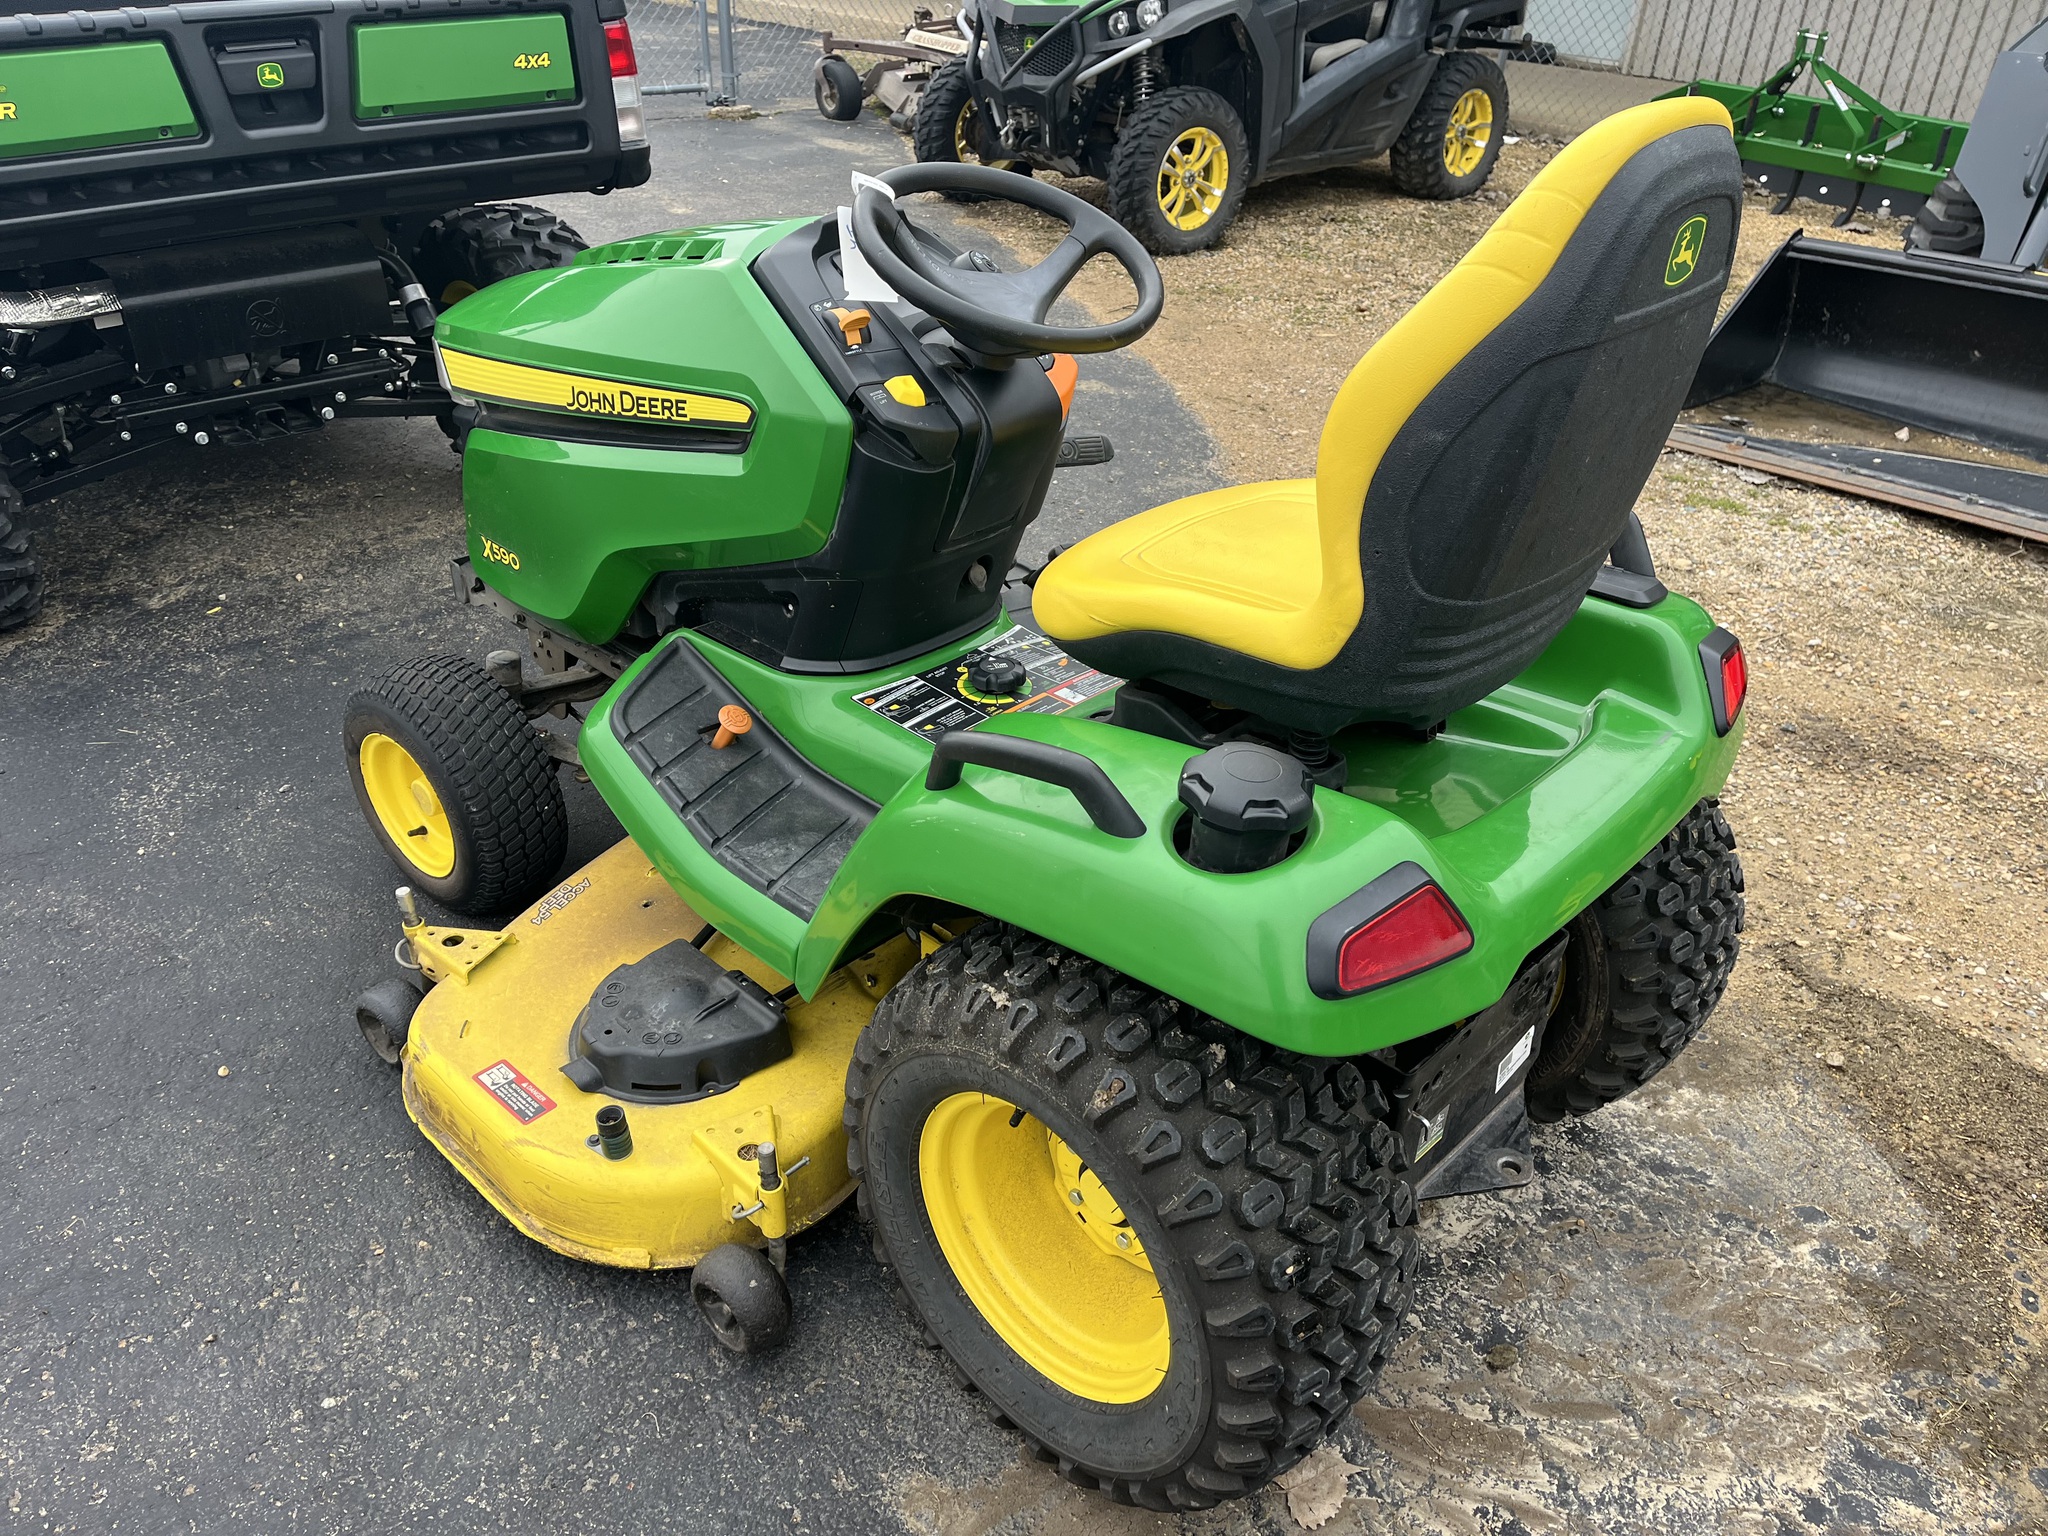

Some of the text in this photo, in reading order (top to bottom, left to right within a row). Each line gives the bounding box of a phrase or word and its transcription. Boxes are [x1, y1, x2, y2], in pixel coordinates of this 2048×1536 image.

[566, 386, 689, 419] JOHN DEERE
[480, 534, 520, 571] X590
[531, 877, 591, 925] ACCEL 54
[537, 883, 573, 912] DEEP
[526, 1084, 546, 1102] DANGER
[870, 1131, 944, 1325] CARLISLE
